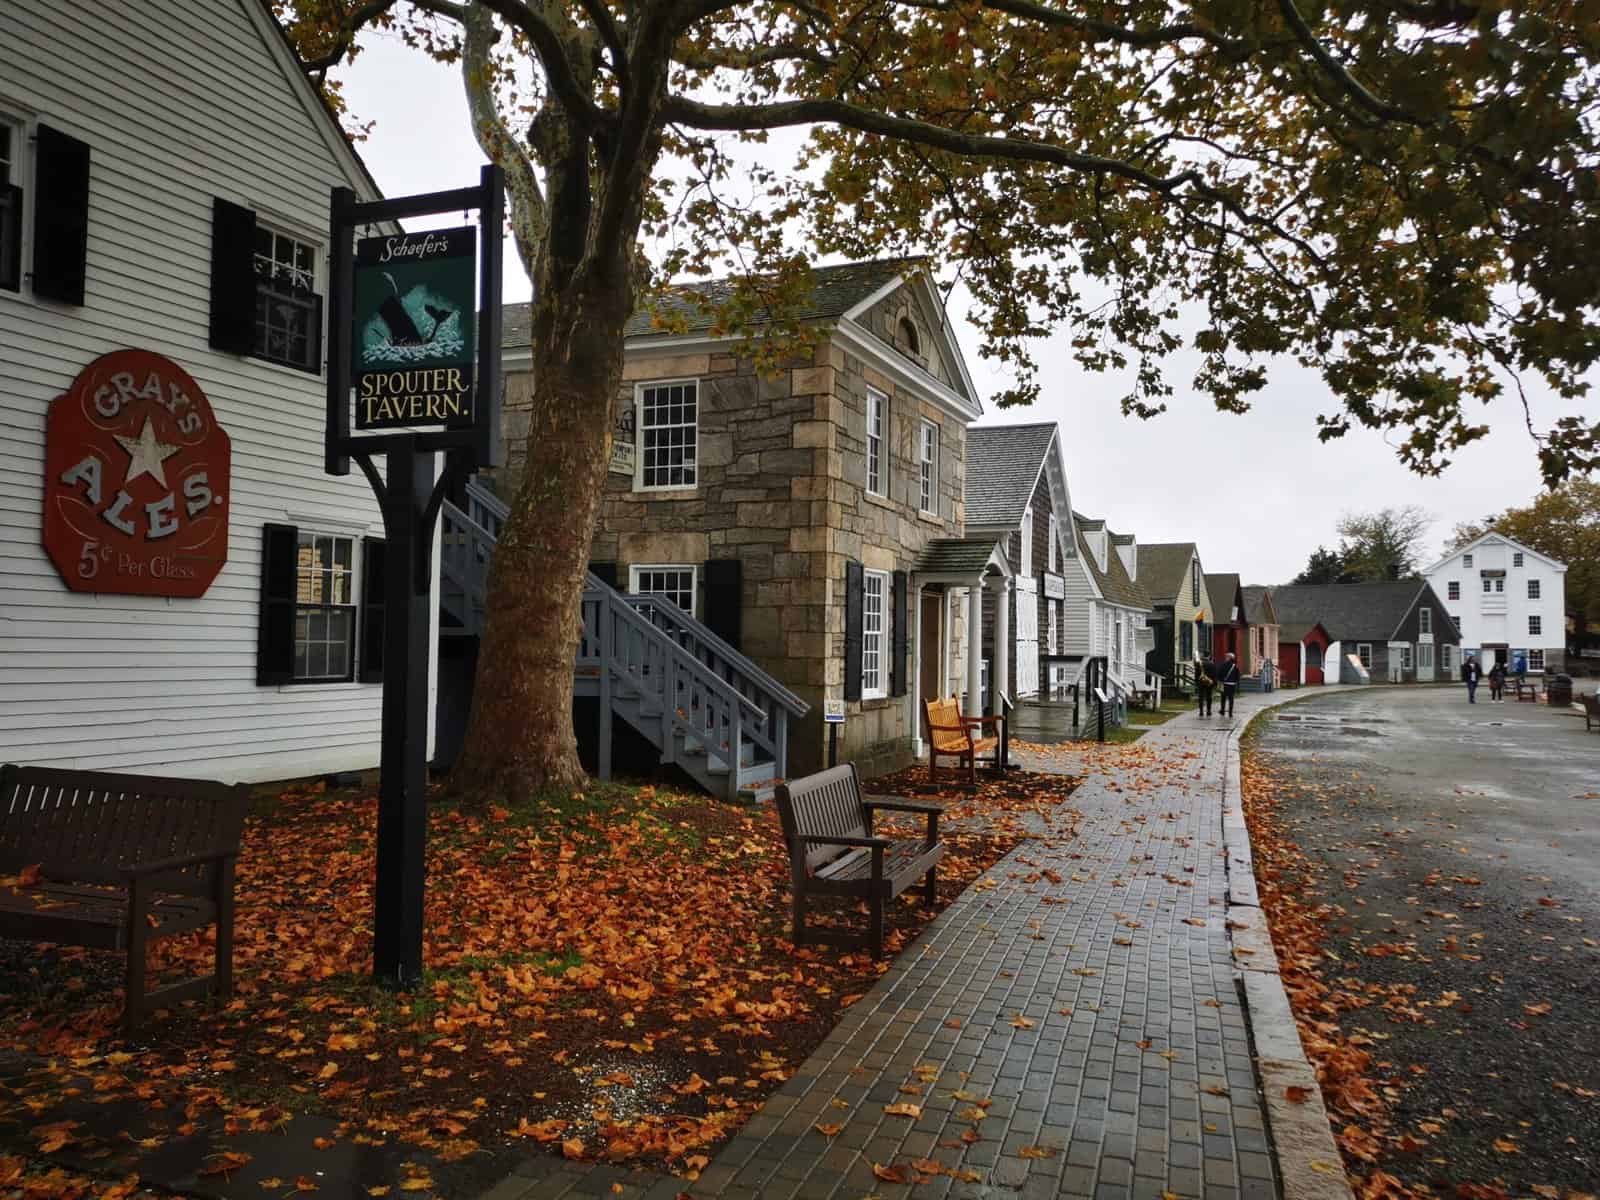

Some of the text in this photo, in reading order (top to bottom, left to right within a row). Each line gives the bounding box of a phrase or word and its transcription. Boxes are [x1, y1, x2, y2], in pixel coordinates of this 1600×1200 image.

[378, 233, 449, 263] Schaefer's
[361, 367, 470, 398] SPOUTER
[360, 392, 470, 424] TAVERN.
[61, 455, 223, 539] ALES.
[118, 553, 145, 577] Per
